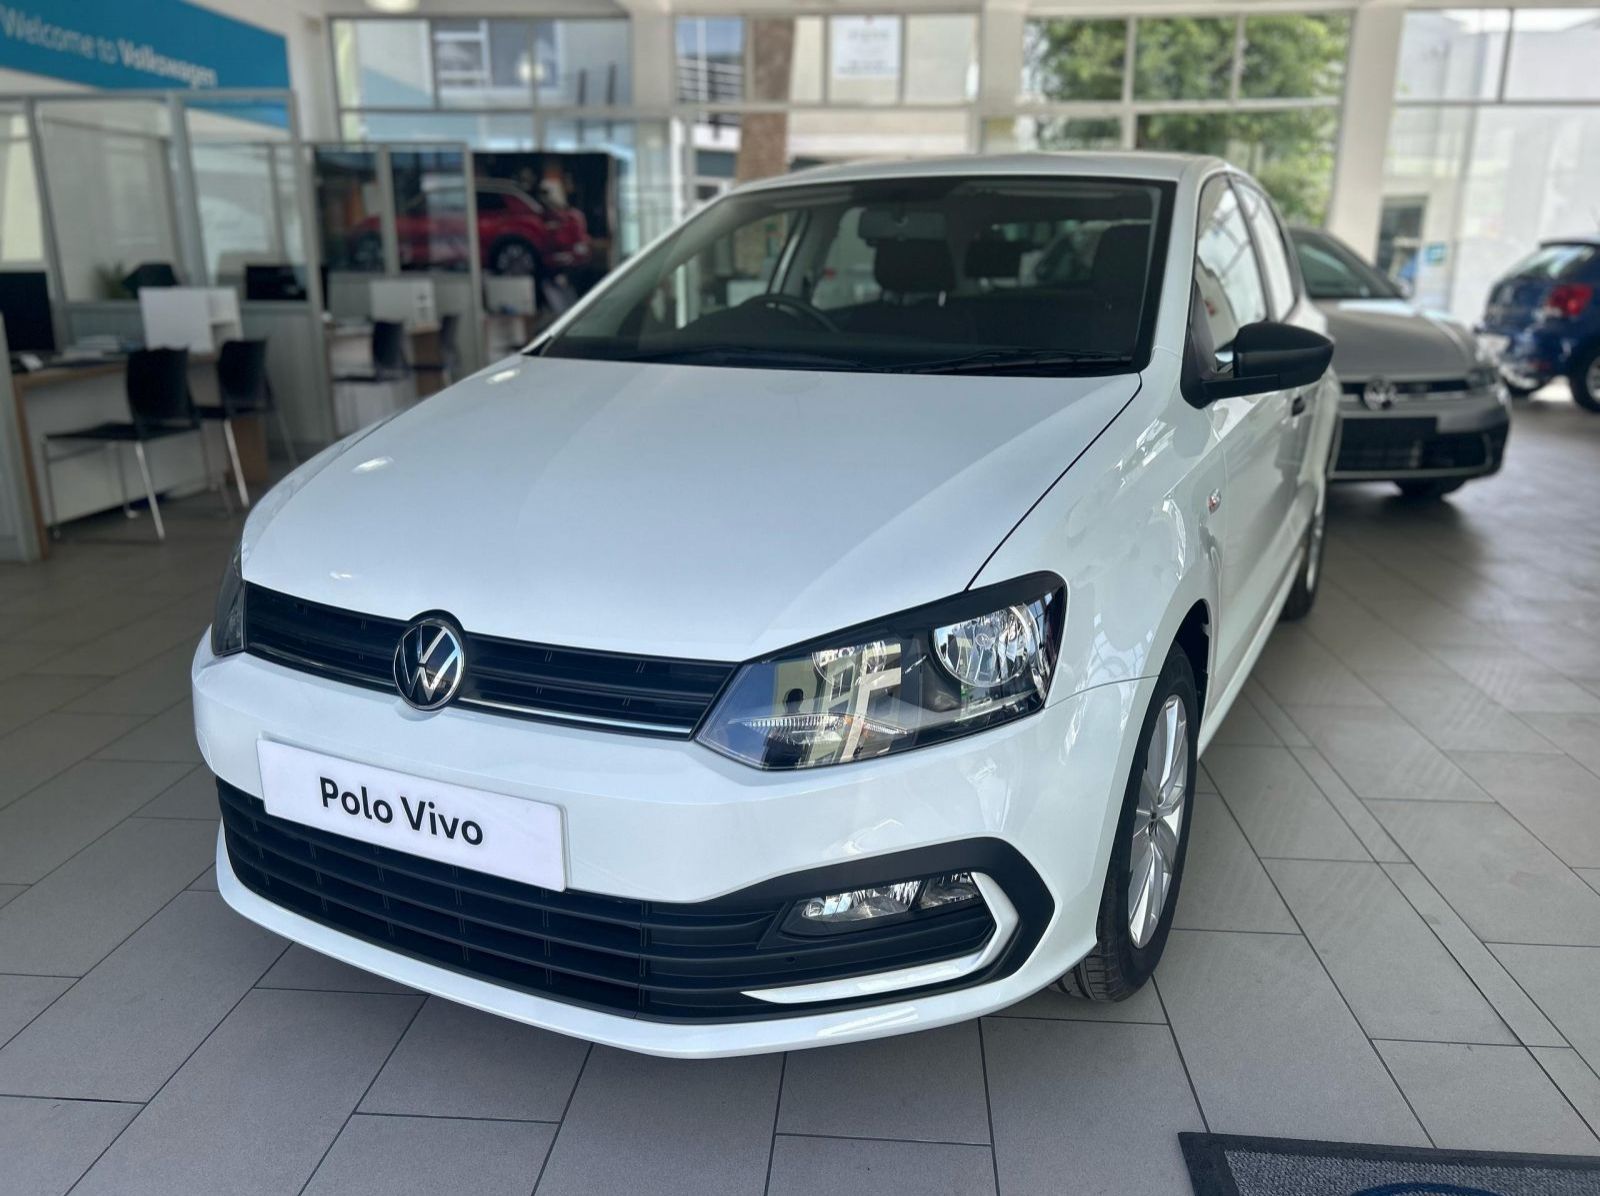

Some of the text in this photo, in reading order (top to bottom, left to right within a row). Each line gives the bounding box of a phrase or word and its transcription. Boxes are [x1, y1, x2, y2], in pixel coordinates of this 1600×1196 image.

[1, 6, 218, 89] Welcome to Volkswagen
[319, 775, 483, 846] Polo Vivo
